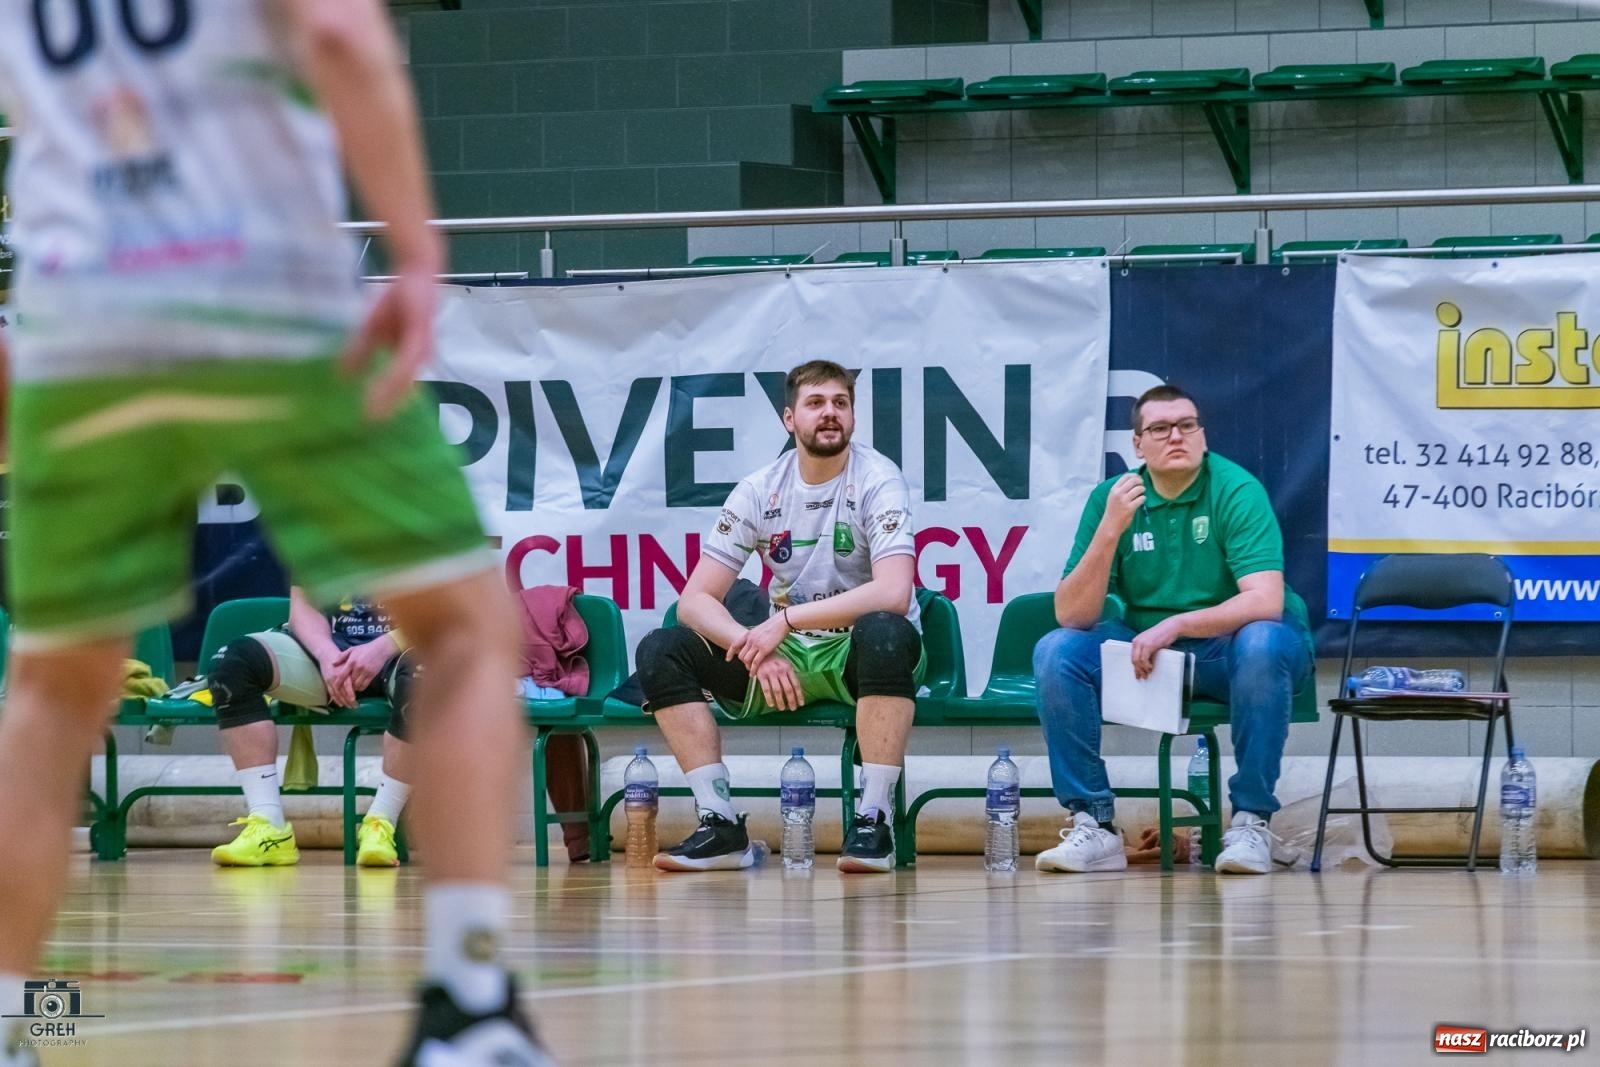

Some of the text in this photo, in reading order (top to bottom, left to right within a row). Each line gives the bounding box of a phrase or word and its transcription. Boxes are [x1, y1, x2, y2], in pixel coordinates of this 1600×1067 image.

[1436, 302, 1600, 408] inst
[1365, 441, 1599, 469] tel. 32 414 92 88,
[1383, 482, 1600, 509] 47-400 Racibór
